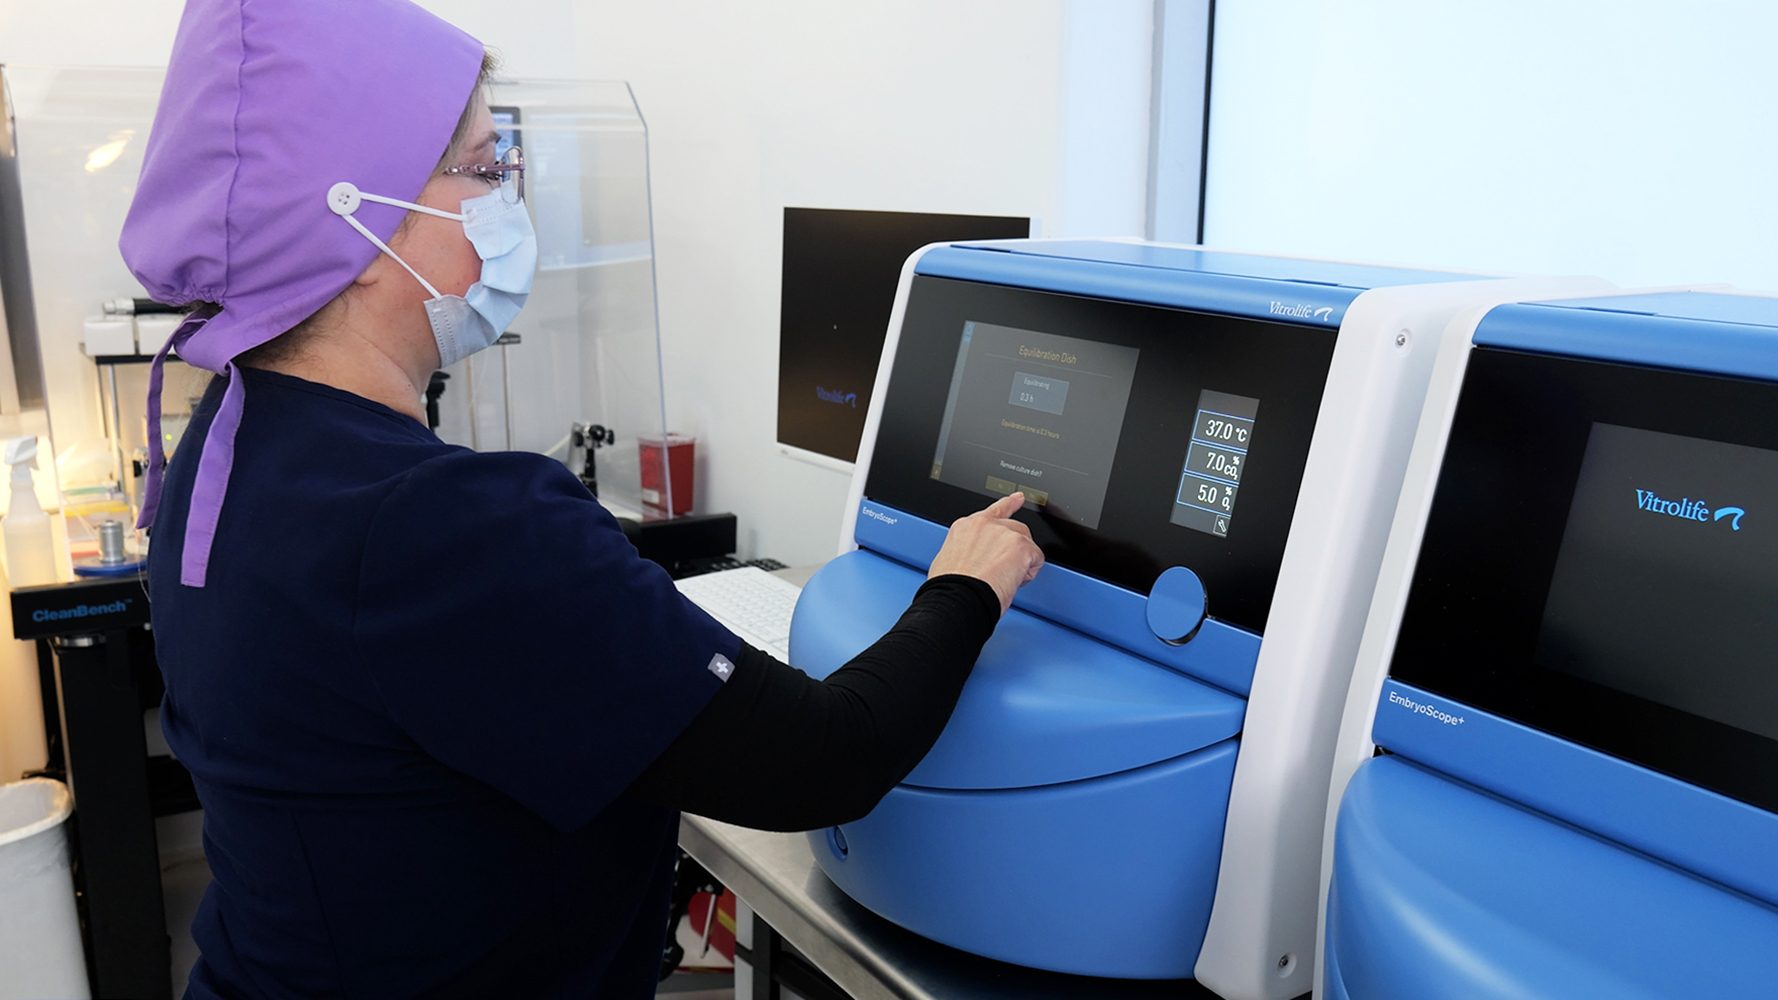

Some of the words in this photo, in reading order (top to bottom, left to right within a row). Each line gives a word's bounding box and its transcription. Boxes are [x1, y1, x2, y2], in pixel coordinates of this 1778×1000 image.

[1269, 300, 1312, 319] Vitrolife
[1060, 352, 1077, 364] Dish
[1205, 419, 1233, 440] 37.0
[1206, 452, 1225, 471] 7.0
[1232, 456, 1240, 466] %
[1198, 484, 1217, 504] 5.0
[1225, 486, 1232, 496] %
[1636, 489, 1709, 522] Vitrolife
